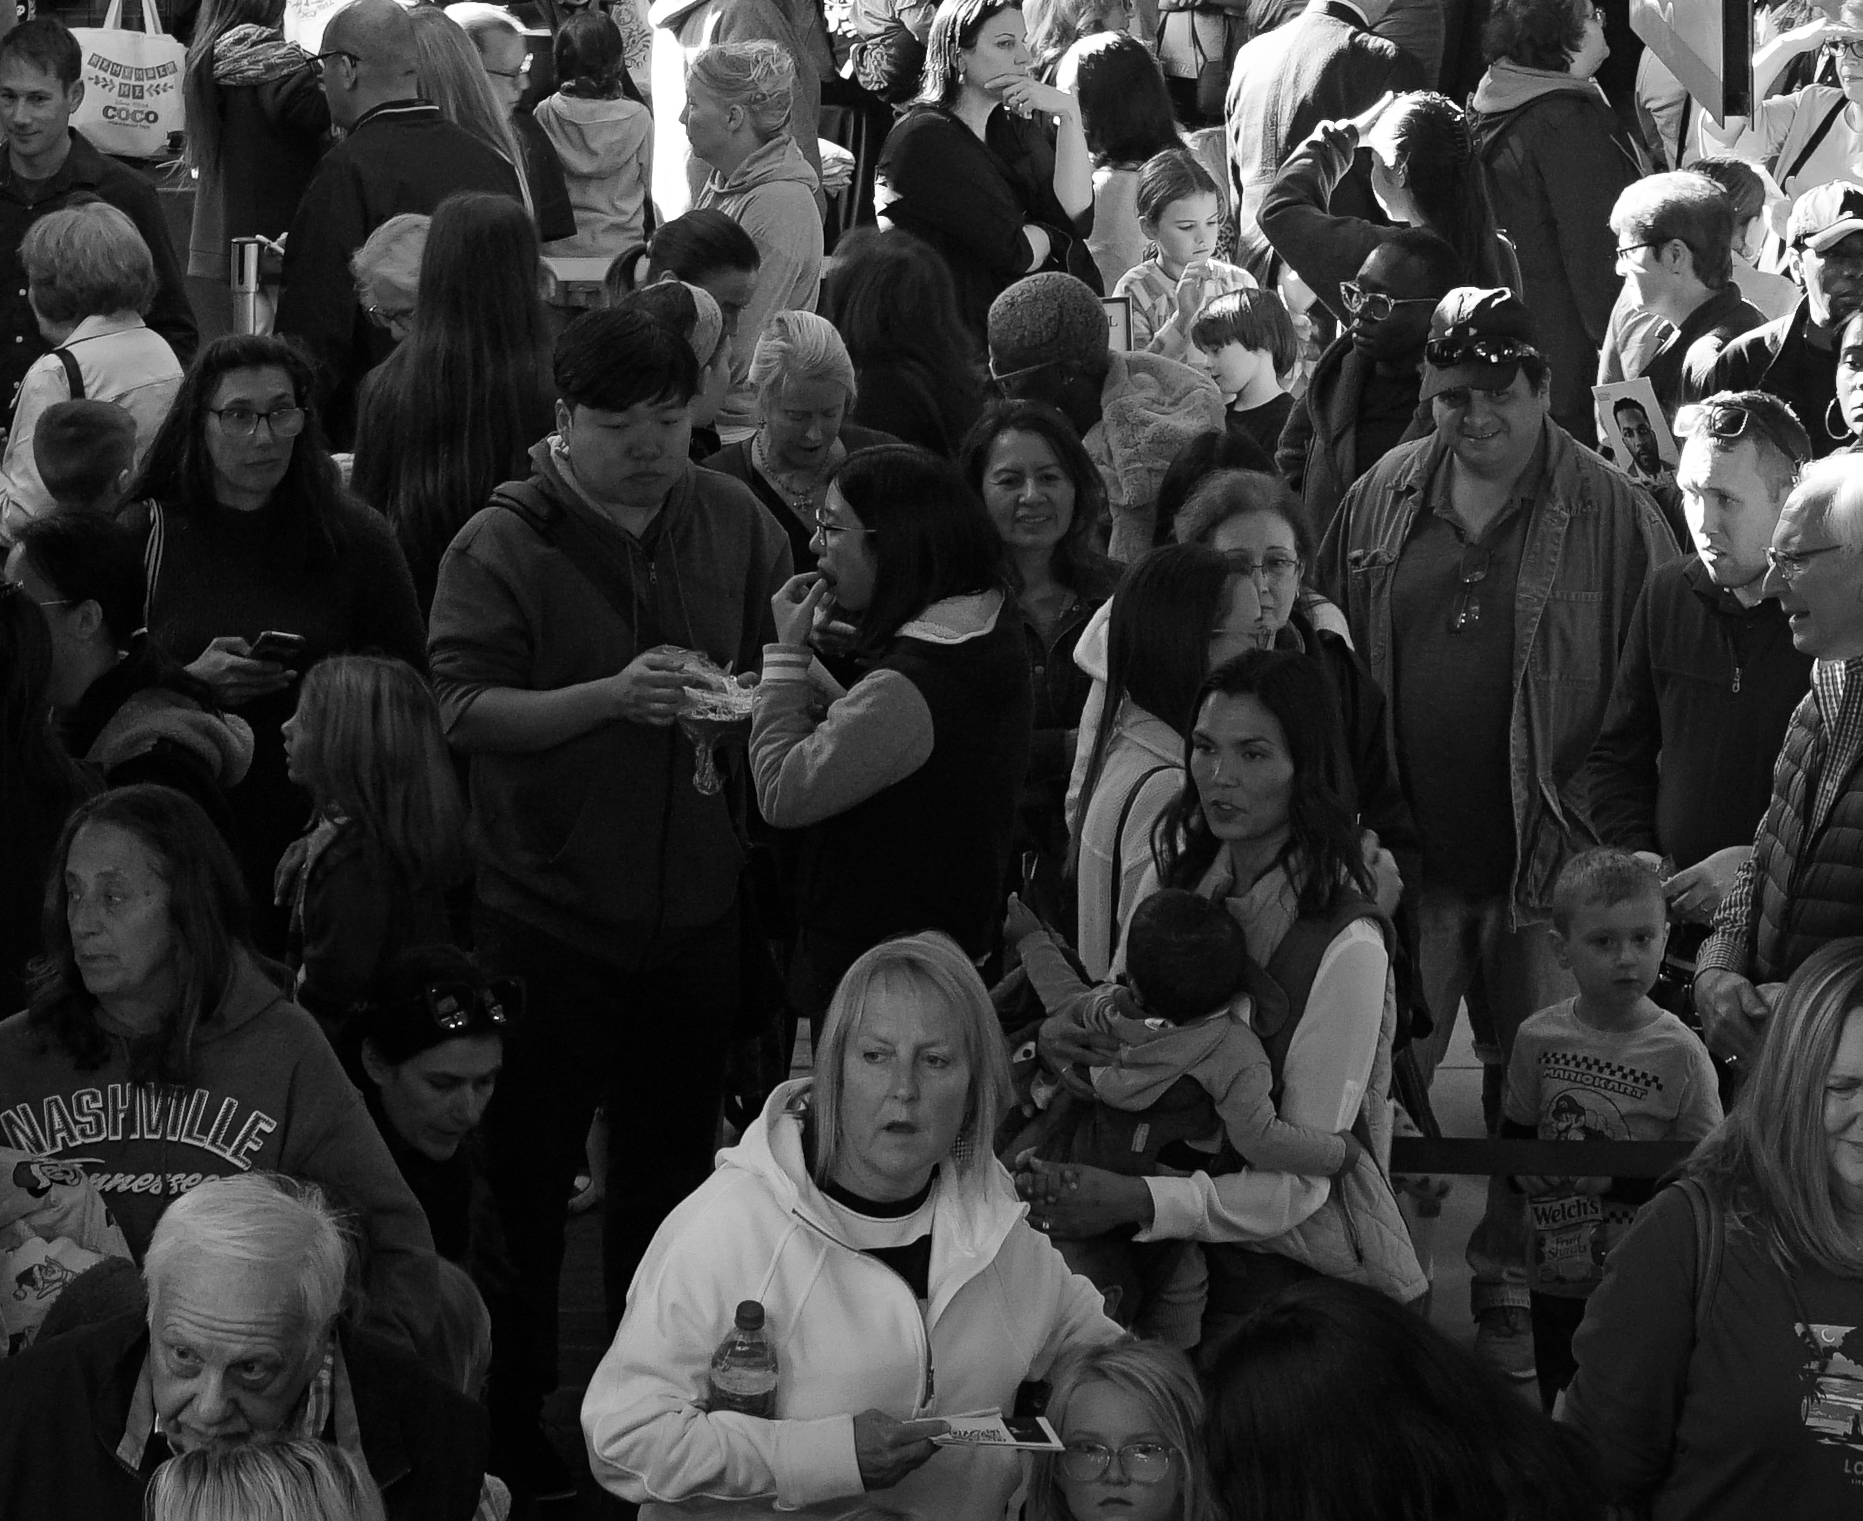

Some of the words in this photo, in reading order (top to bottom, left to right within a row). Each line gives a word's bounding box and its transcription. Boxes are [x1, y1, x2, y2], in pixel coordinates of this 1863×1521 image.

[102, 105, 159, 124] COCO
[0, 1081, 277, 1171] NASHVILLE
[1534, 1198, 1599, 1226] Welch's
